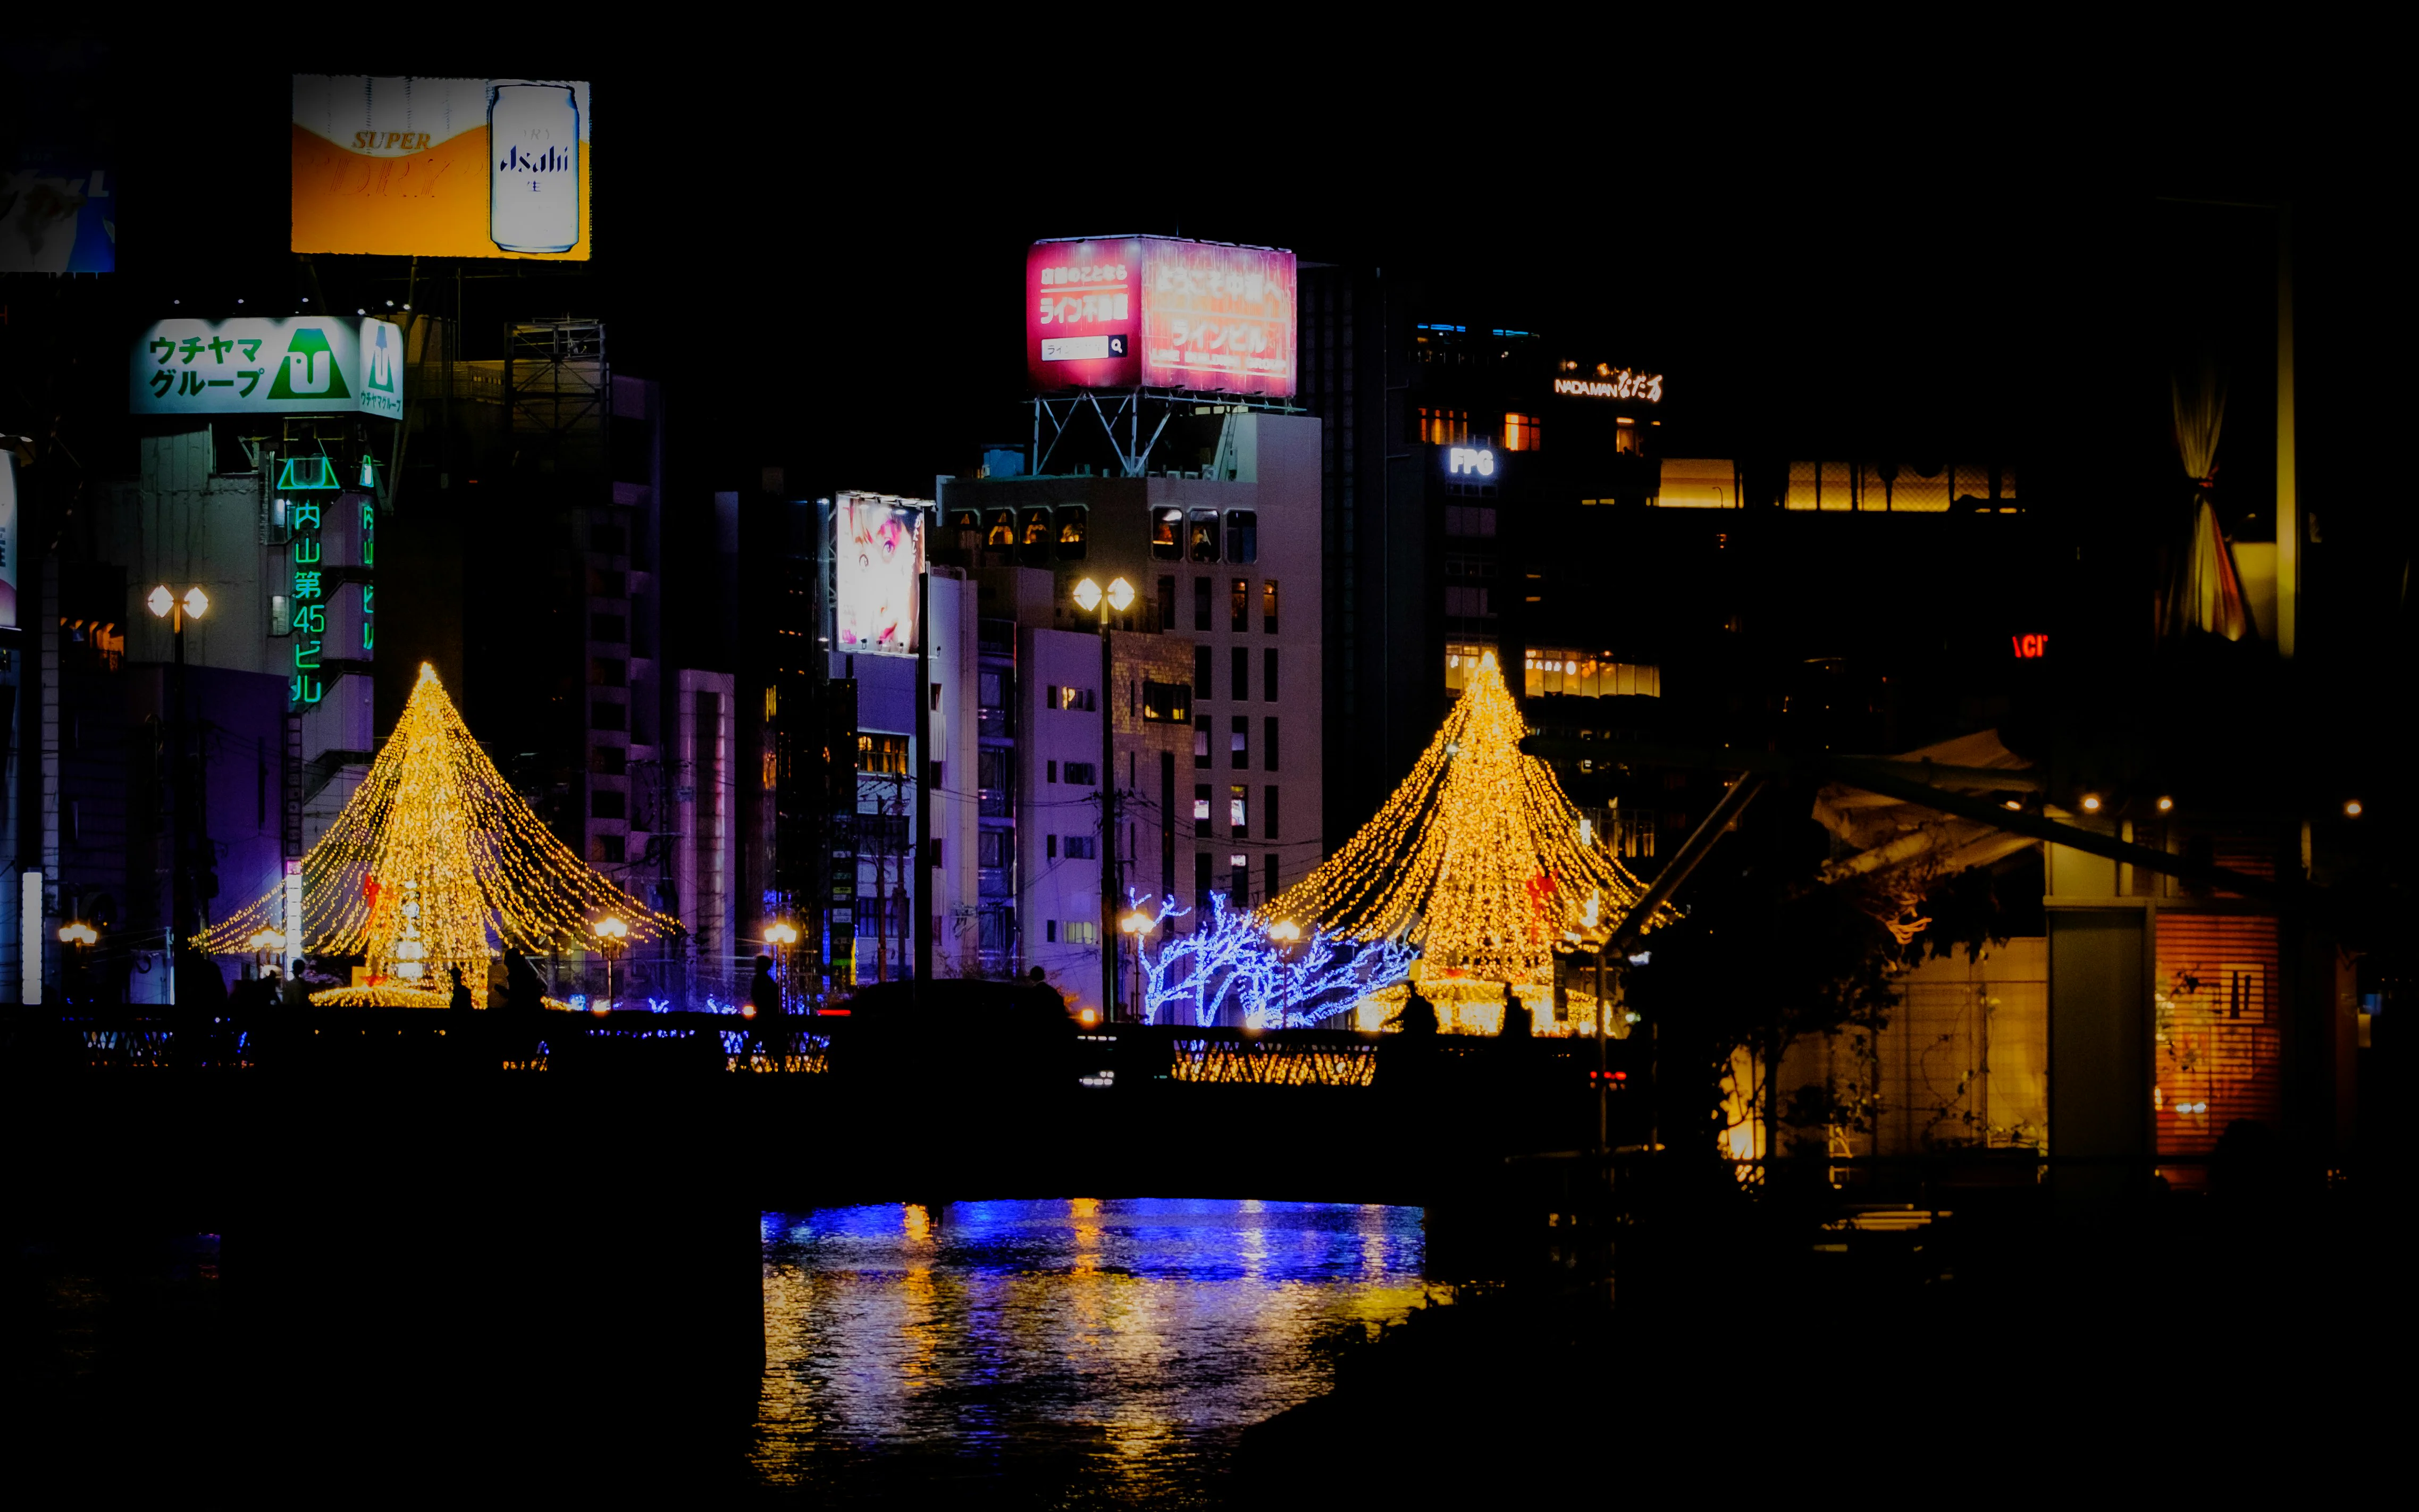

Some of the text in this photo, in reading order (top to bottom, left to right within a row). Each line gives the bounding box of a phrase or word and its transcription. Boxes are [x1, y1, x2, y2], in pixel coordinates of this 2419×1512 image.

[353, 131, 432, 150] SUPER
[500, 144, 568, 173] Asahi
[1157, 265, 1282, 302] ようこそ中へ
[1040, 293, 1129, 325] ライン不
[149, 336, 263, 365] ウチヤマ
[149, 368, 265, 399] グループ
[1555, 379, 1618, 398] NADAMAN
[1450, 447, 1494, 475] FPG
[292, 500, 326, 703] 内山第45ビル
